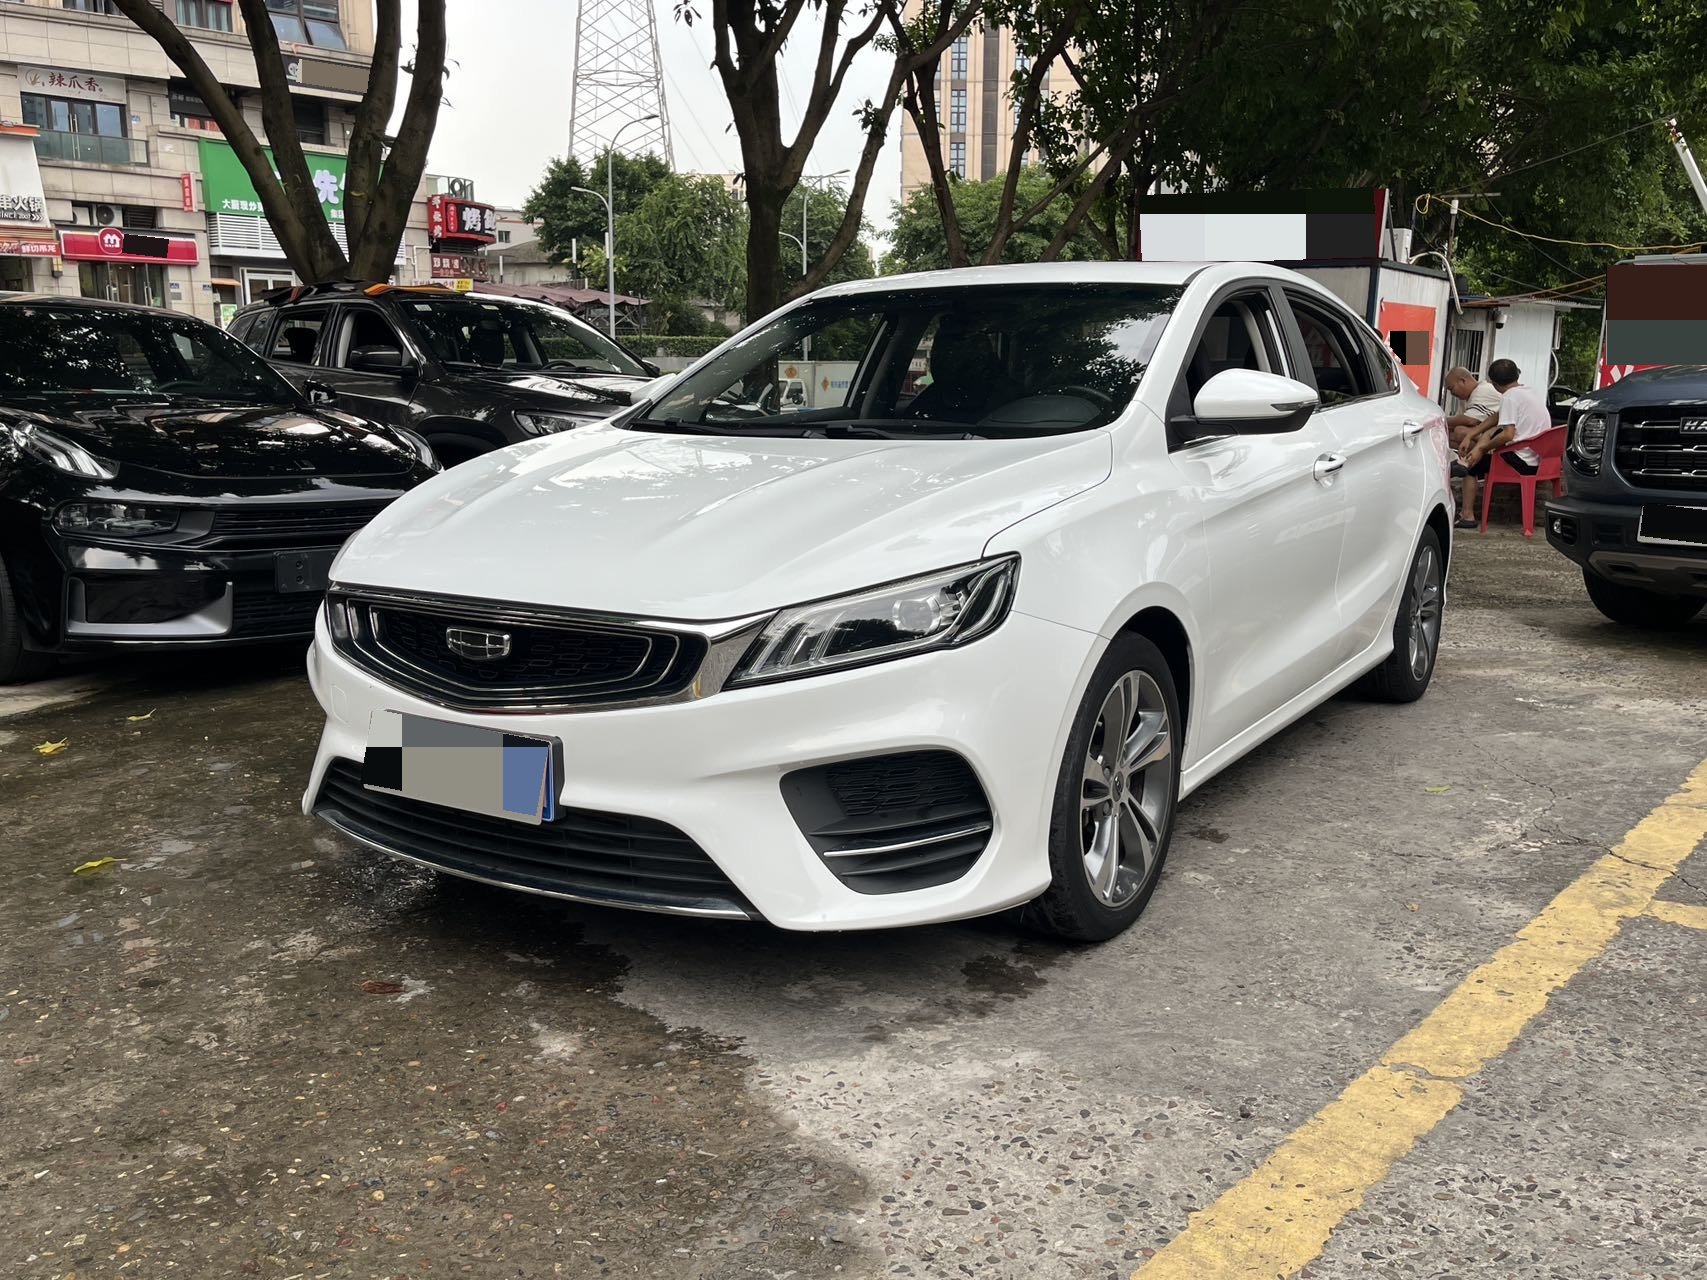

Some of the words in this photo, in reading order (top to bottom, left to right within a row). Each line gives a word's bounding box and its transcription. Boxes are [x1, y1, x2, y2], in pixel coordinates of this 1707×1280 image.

[48, 72, 99, 92] 辣爪香
[313, 169, 346, 204] 先
